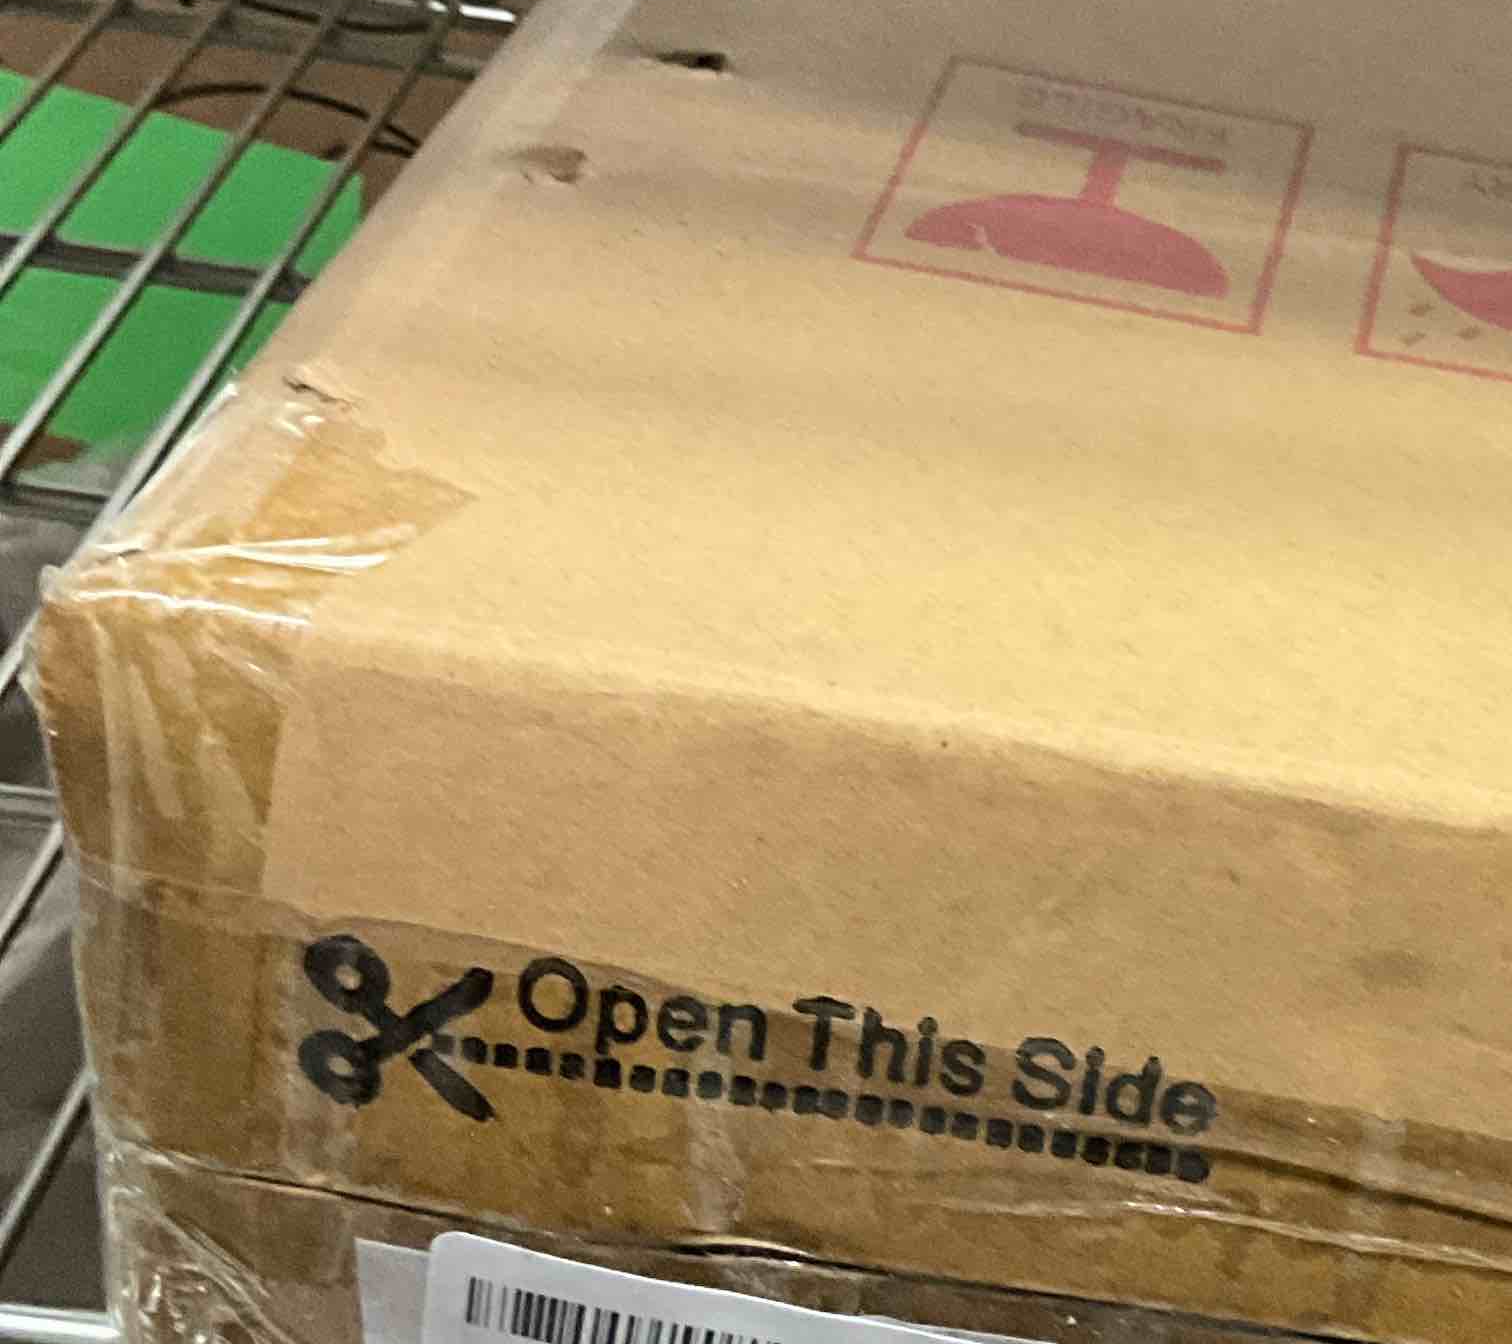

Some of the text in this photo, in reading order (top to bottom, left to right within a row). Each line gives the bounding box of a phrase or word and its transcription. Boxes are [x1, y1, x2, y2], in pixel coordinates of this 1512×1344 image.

[518, 956, 1220, 1136] Open This Side
